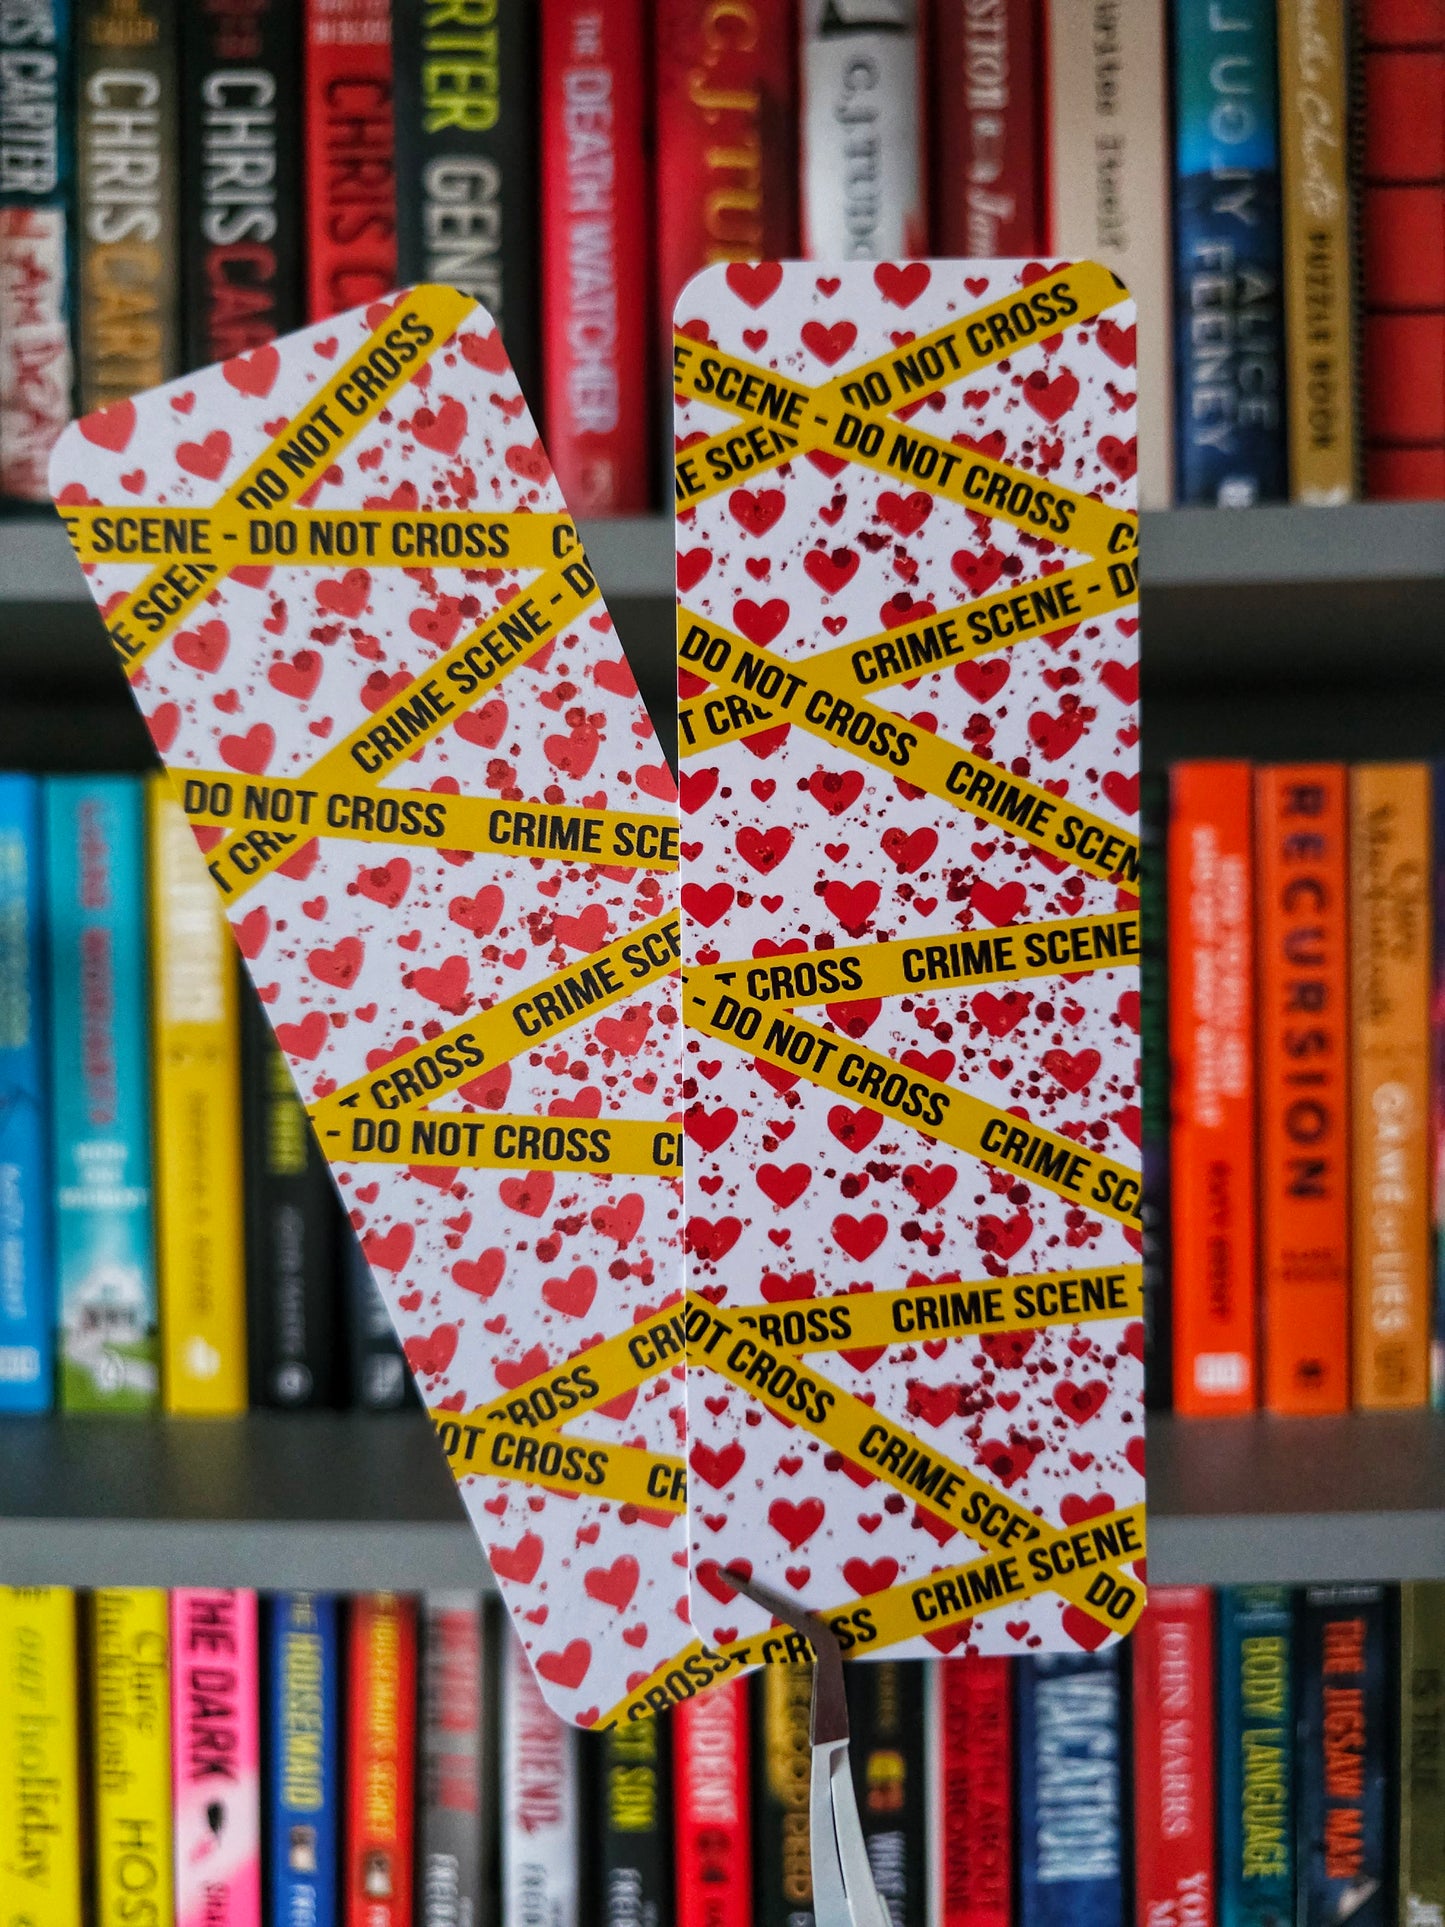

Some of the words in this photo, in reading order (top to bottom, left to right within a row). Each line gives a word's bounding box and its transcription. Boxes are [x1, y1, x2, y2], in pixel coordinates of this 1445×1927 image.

[2, 49, 57, 195] CARTER
[87, 67, 162, 244] CHRIS
[203, 68, 278, 246] CHRIS
[325, 75, 395, 260] CHRIS
[563, 67, 615, 213] DEATH
[705, 140, 763, 262] TU
[89, 245, 164, 402] CART
[204, 248, 279, 360] CAR
[568, 220, 620, 434] WATCHER
[839, 371, 893, 412] DO
[892, 333, 963, 394] NOT
[965, 282, 1078, 358] CROSS
[1191, 241, 1238, 455] FEENEY
[1236, 269, 1280, 431] ALICE
[236, 467, 290, 512] DO
[278, 405, 344, 479] NOT
[334, 312, 435, 417] CROSS
[693, 358, 810, 429] SCENE
[833, 412, 885, 459] DO
[887, 433, 962, 488] NOT
[962, 464, 1077, 535] CROSS
[1107, 522, 1138, 555] C
[91, 517, 212, 554] SCENE
[249, 519, 298, 555] DO
[309, 520, 382, 557] NOT
[391, 521, 510, 559] CROSS
[552, 523, 583, 560] C
[350, 679, 456, 774] CRIME
[446, 598, 552, 695] SCENE
[851, 619, 965, 685] CRIME
[967, 579, 1082, 646] SCENE
[679, 624, 732, 673] DO
[731, 651, 808, 709] NOT
[804, 689, 918, 767] CROSS
[945, 760, 1057, 839] CRIME
[184, 779, 234, 818] DO
[244, 784, 319, 826] NOT
[326, 793, 447, 838] CROSS
[489, 809, 605, 854] CRIME
[370, 1033, 485, 1110] CROSS
[511, 956, 624, 1037] CRIME
[746, 956, 864, 1002] CROSS
[902, 936, 1017, 983] CRIME
[1023, 920, 1141, 968] SCENE
[1281, 782, 1329, 1201] RECURSION
[352, 1117, 402, 1153] DO
[411, 1120, 485, 1157] NOT
[494, 1124, 612, 1163] CROSS
[652, 1131, 683, 1167] C
[709, 994, 763, 1041] DO
[762, 1017, 839, 1074] NOT
[836, 1053, 951, 1127] CROSS
[979, 1118, 1092, 1193] CRIME
[1371, 1081, 1412, 1204] GAME
[737, 1305, 852, 1347] ROSS
[891, 1287, 1005, 1334] CRIME
[1013, 1274, 1129, 1319] SCENE
[1371, 1254, 1411, 1335] LIES
[487, 1364, 600, 1428] ROSS
[628, 1312, 686, 1370] CRI
[433, 1418, 486, 1461] OT
[491, 1431, 609, 1485] CROSS
[684, 1300, 733, 1355] OT
[726, 1338, 836, 1424] CROSS
[858, 1422, 966, 1511] CRIME
[1084, 1570, 1136, 1620] DO
[761, 1607, 877, 1664] CRSS
[911, 1555, 1025, 1623] CRIME
[1027, 1515, 1143, 1582] SCENE
[1321, 1617, 1367, 1677] THE
[187, 1666, 238, 1784] DARK
[285, 1631, 325, 1807] HOUSEMAID
[1156, 1621, 1193, 1713] JOHN
[1241, 1635, 1290, 1719] BODY
[6, 1712, 61, 1887] holiday
[1034, 1670, 1120, 1884] VACATION
[1158, 1718, 1195, 1842] MARRS
[1241, 1727, 1290, 1881] LANGUAGE
[1322, 1685, 1366, 1800] JIGSAW
[1323, 1807, 1366, 1879] MAN
